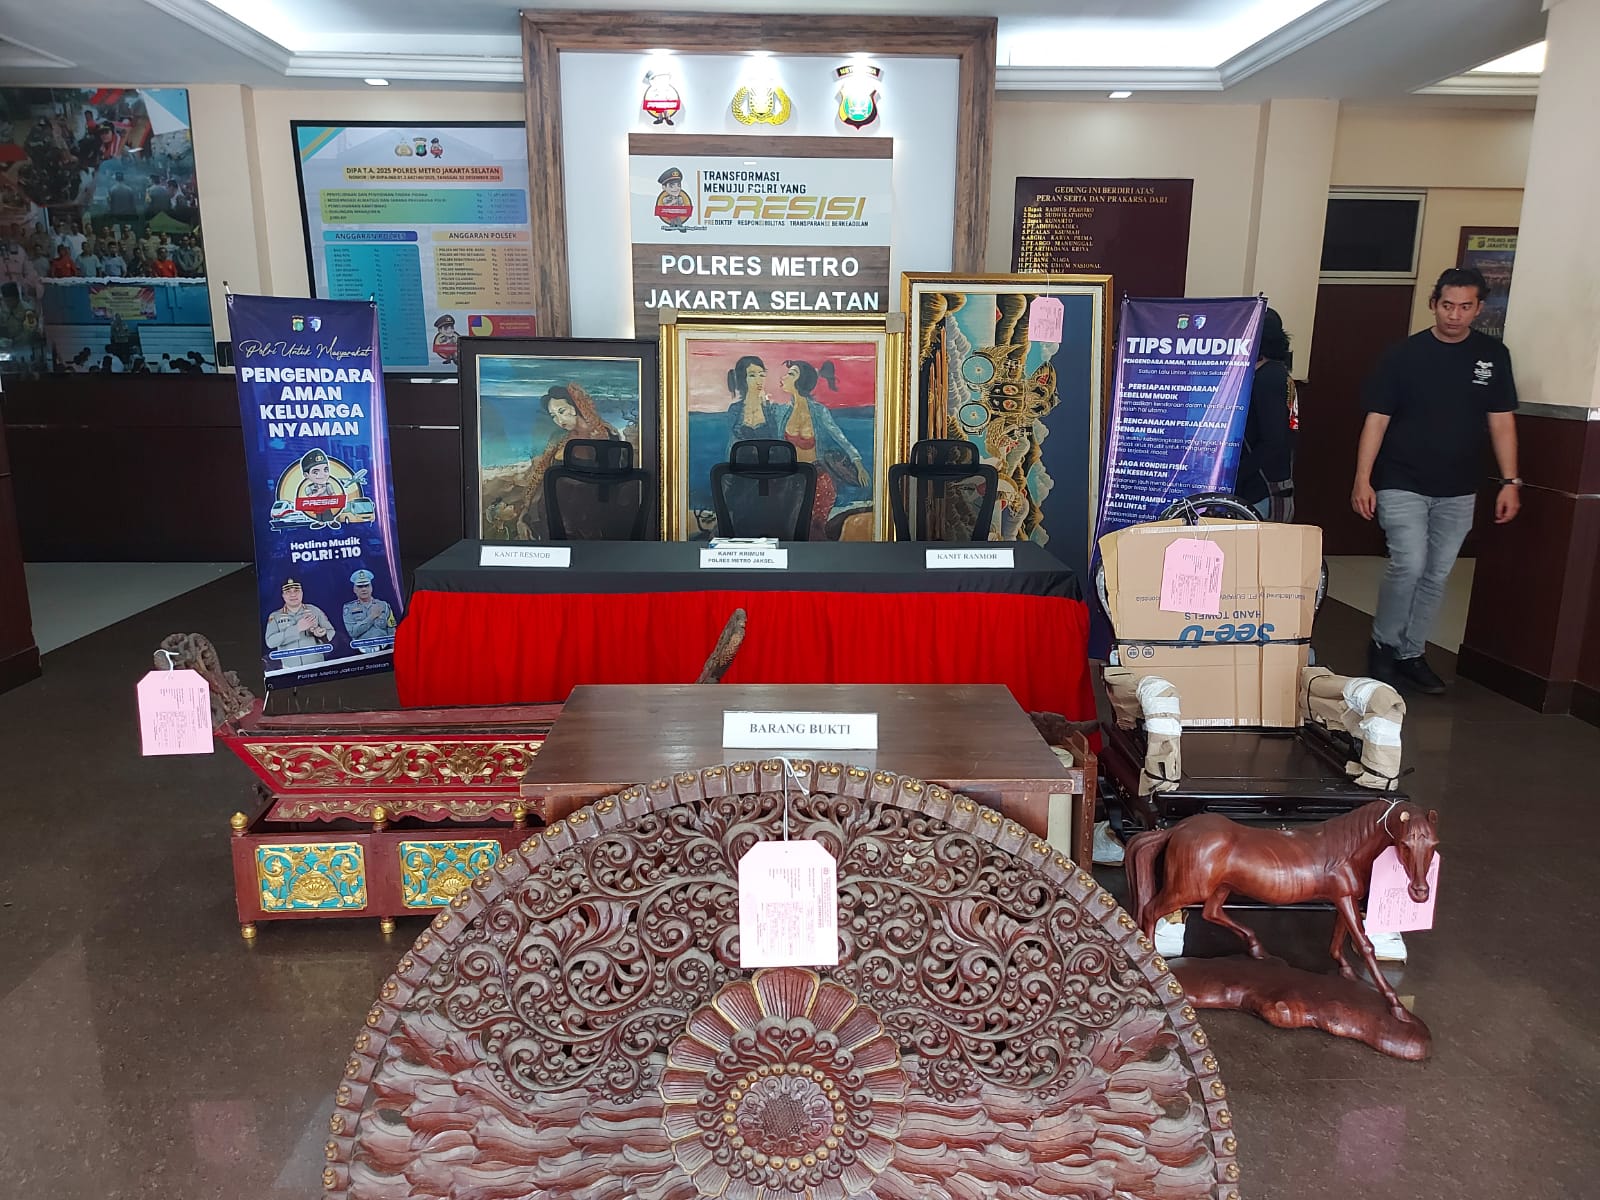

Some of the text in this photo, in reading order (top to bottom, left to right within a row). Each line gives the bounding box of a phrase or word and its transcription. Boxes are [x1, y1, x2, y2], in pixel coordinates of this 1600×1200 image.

[704, 171, 780, 182] TRANSFORMASI
[704, 183, 806, 194] MENUJU POLRI YANG
[704, 196, 866, 220] PRESISI
[661, 255, 859, 276] POLRES METRO
[644, 290, 878, 311] JAKARTA SELATAN
[239, 336, 374, 360] Polri Untuk Masyarakat
[1127, 337, 1252, 356] TIPS MUDIK
[241, 367, 375, 383] PENGENDARA
[280, 386, 342, 401] AMAN
[259, 404, 364, 420] KELUARGA
[269, 422, 359, 438] NYAMAN
[1123, 418, 1176, 426] RENCANAKAN
[1176, 420, 1227, 429] PERJALANAN
[1127, 469, 1168, 478] KESEHATAN
[302, 498, 339, 507] PRESISI
[1123, 502, 1146, 510] LINTAS
[290, 536, 360, 550] Hotline Mudik
[291, 546, 361, 563] POLRI : 110
[1232, 611, 1261, 619] HAND
[1176, 623, 1275, 648] See-U
[340, 665, 364, 675] Jakarta
[750, 723, 851, 735] BARANG BUKTI
